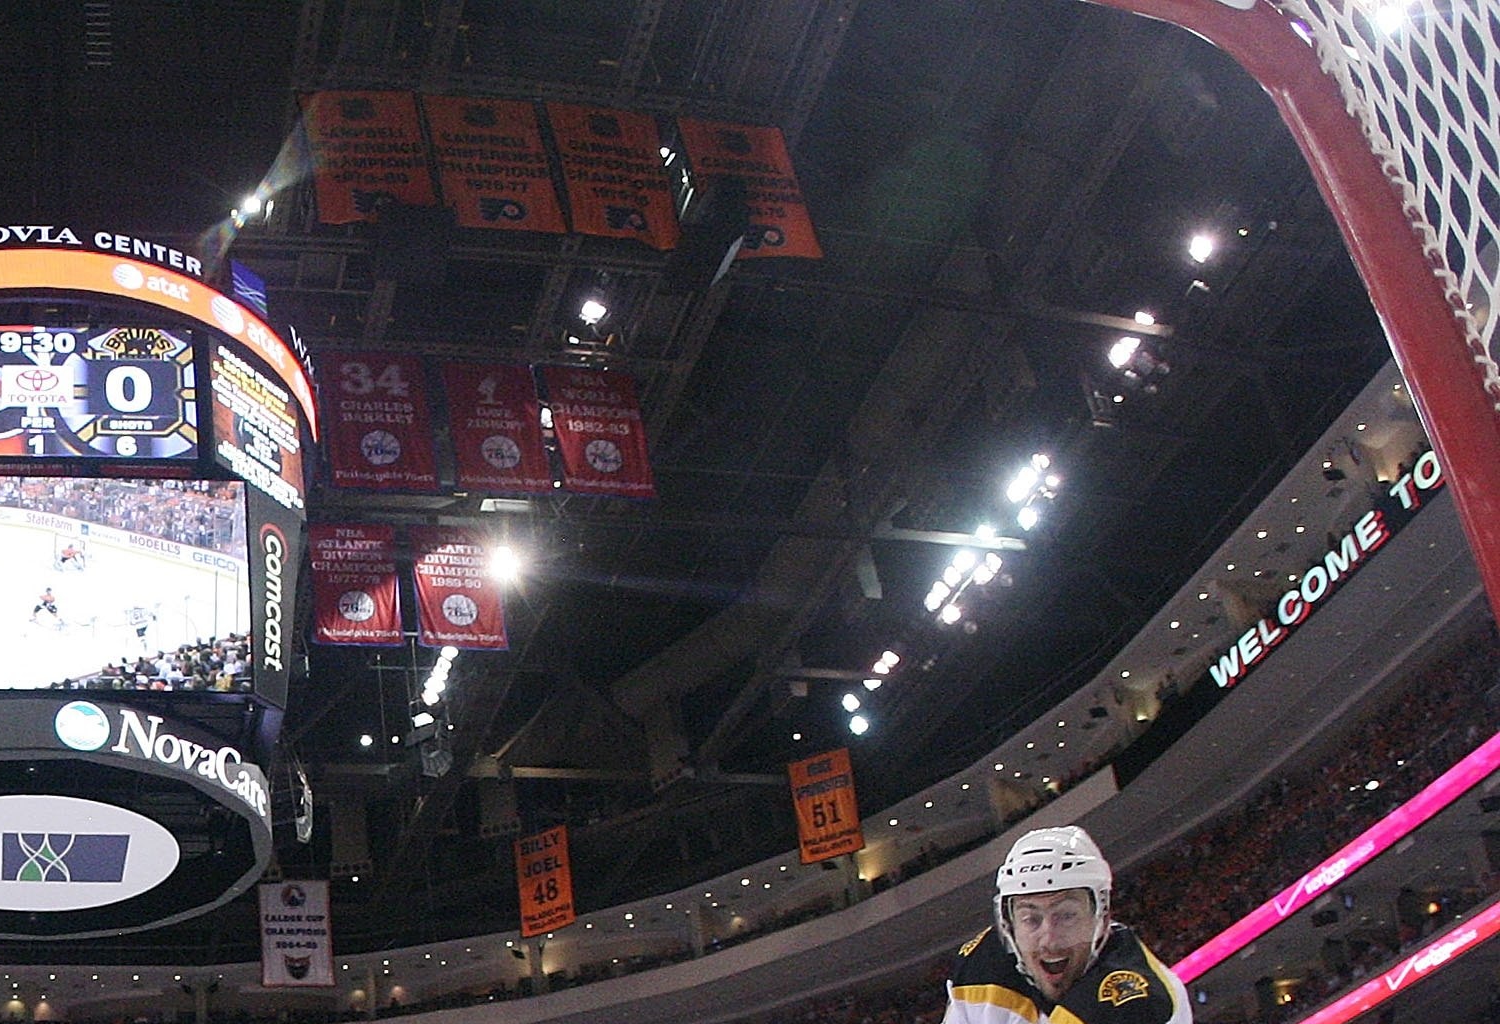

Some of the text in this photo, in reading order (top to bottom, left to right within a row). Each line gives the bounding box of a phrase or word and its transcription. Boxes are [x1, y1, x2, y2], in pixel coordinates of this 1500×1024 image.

[94, 231, 202, 276] CENTER
[0, 331, 77, 353] 9:30
[104, 327, 172, 351] BRUINS
[104, 364, 152, 413] 0
[340, 361, 411, 397] 34
[7, 393, 68, 405] TOYOTA
[340, 401, 414, 413] CHARLES
[20, 416, 56, 430] PER
[566, 419, 630, 435] 1982-83
[27, 433, 45, 455] 1
[115, 435, 138, 457] 6
[336, 528, 365, 538] NBA
[128, 533, 181, 556] MODELL'S
[317, 540, 384, 550] ATLANTIC
[191, 550, 237, 573] GEICO
[322, 551, 382, 561] DIVISION
[312, 562, 396, 573] CHAMPIONS
[1209, 450, 1442, 689] WELCOME TO
[317, 627, 374, 638] Philadelphia
[112, 709, 267, 818] NovaCare
[813, 800, 842, 829] 51
[520, 831, 560, 856] BILLY
[524, 856, 562, 878] JOEL
[1018, 863, 1054, 874] CCM
[534, 877, 558, 905] 48
[265, 927, 327, 936] CHAMPIONS
[1101, 972, 1149, 998] BOSTON
